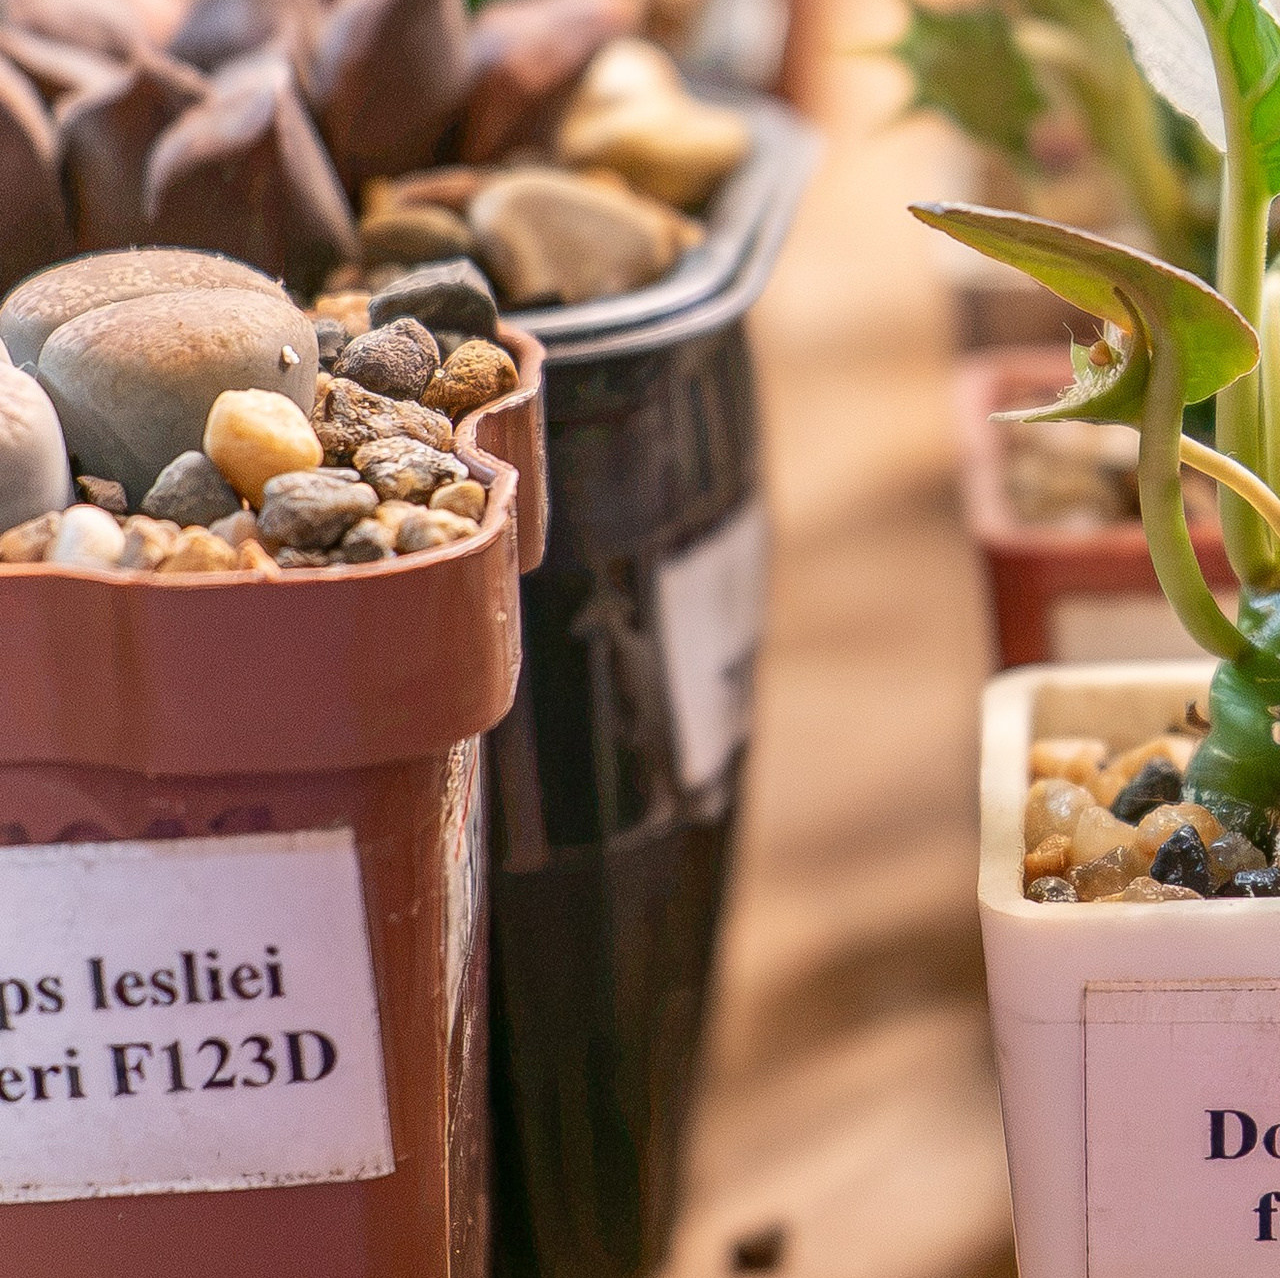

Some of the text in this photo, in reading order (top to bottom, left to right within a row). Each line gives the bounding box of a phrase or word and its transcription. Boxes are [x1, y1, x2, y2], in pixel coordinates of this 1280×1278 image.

[0, 945, 286, 1032] ps lesliei
[0, 1029, 338, 1103] eri F123D
